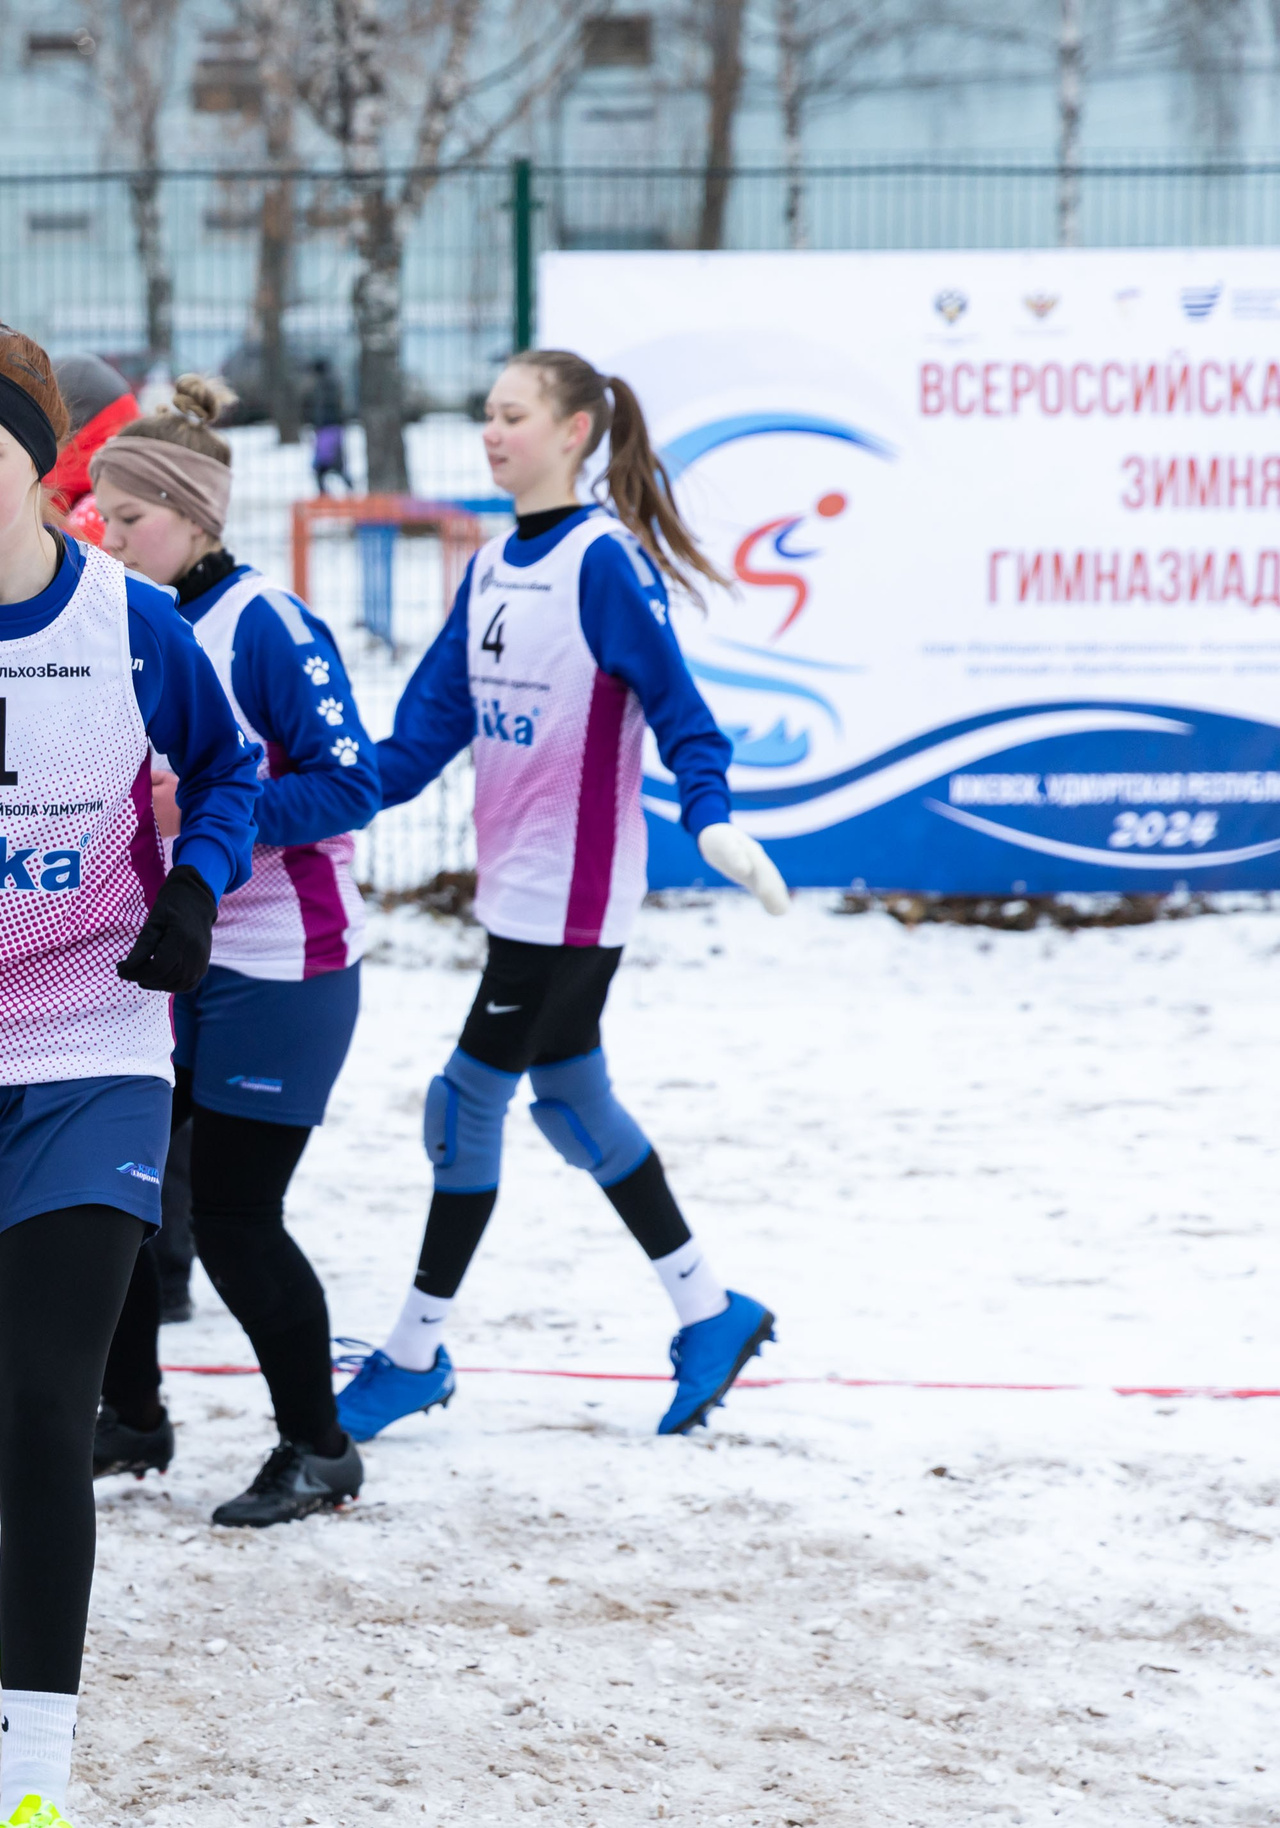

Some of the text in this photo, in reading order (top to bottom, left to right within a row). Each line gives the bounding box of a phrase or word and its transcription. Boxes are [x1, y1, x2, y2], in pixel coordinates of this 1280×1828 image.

[482, 603, 507, 664] 4
[472, 698, 533, 746] ika
[43, 800, 103, 817] УДМУРТИИ
[1108, 811, 1218, 848] 2024
